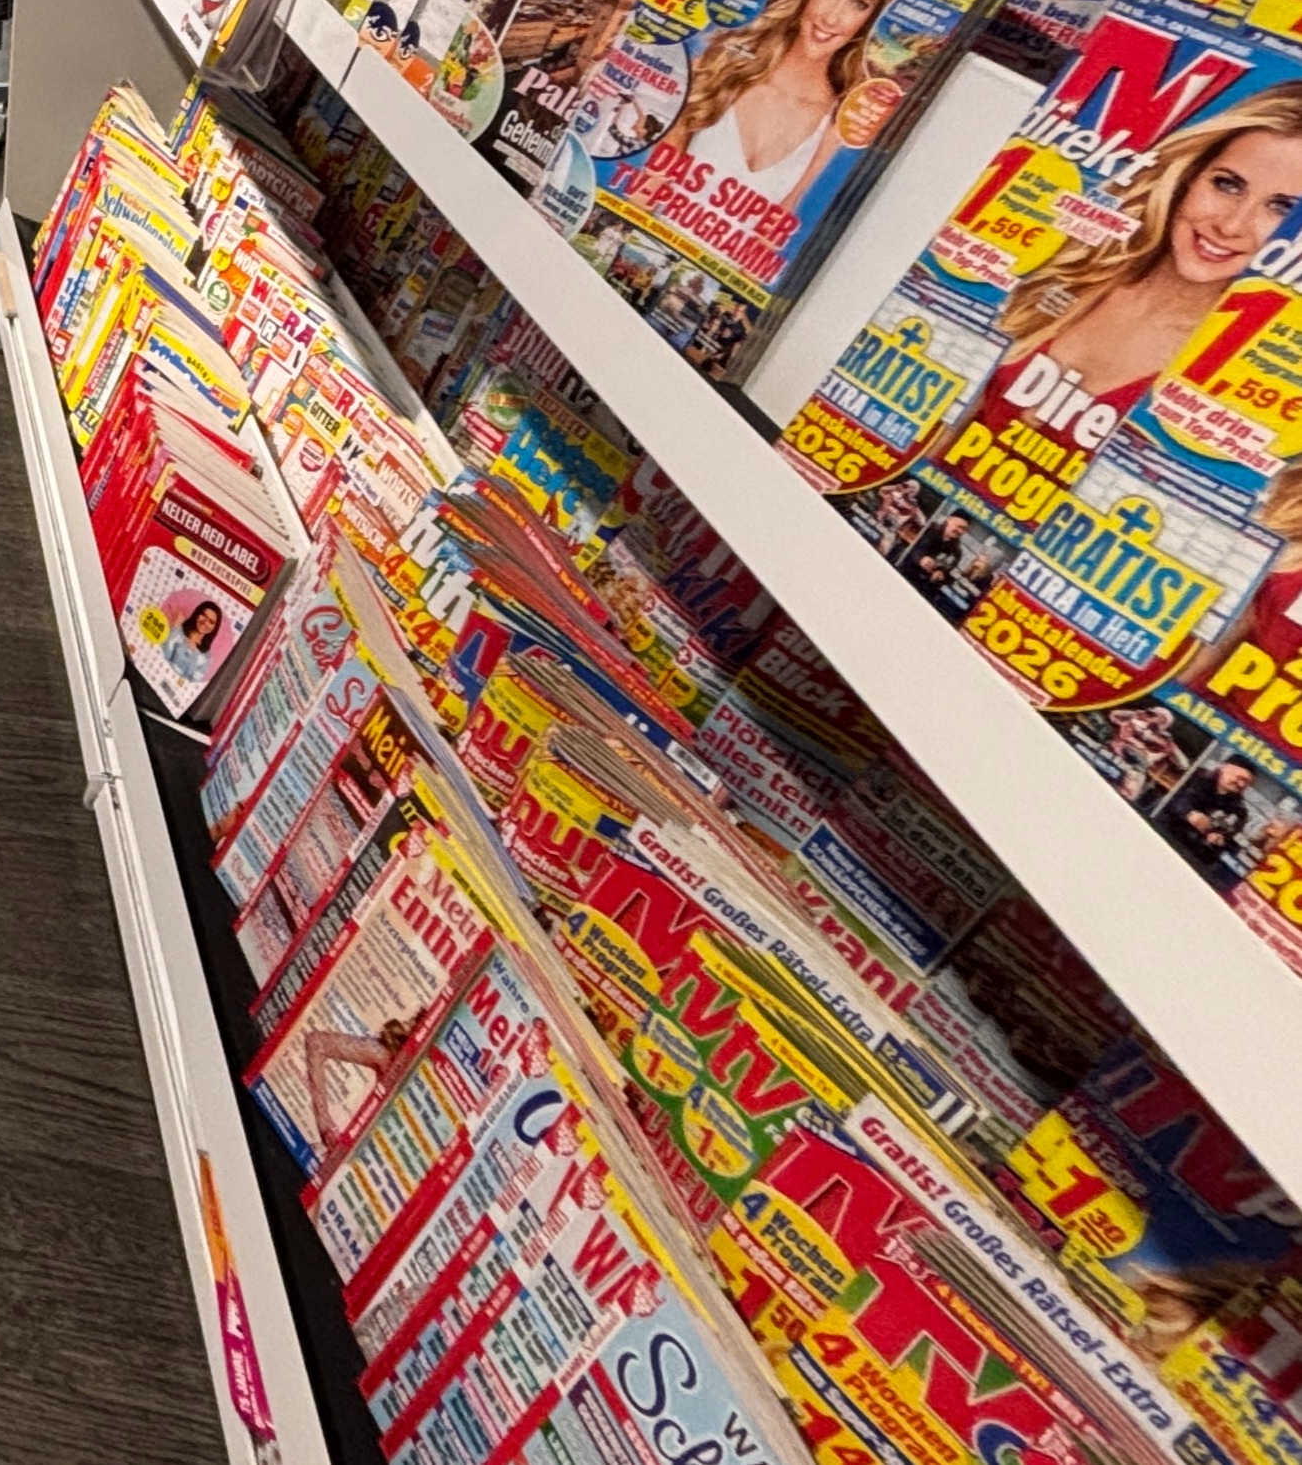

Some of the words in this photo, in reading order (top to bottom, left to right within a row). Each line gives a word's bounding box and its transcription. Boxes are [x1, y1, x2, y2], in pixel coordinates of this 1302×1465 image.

[606, 162, 787, 284] TV-PROGRAMM
[646, 141, 716, 197] DAS
[708, 174, 801, 249] SUPER
[836, 328, 958, 423] GRATIS!
[1151, 399, 1187, 431] zum
[1160, 380, 1204, 416] Mehr
[785, 415, 862, 484] 2026
[916, 462, 958, 499] Alle
[998, 417, 1072, 470] zum
[159, 495, 202, 540] KELTER
[198, 522, 228, 553] RED
[223, 534, 263, 574] LABEL
[1033, 500, 1204, 633] GRATIS!
[1010, 551, 1077, 620] EXTRA
[1099, 615, 1153, 663] Heft
[756, 647, 855, 720] Blick
[965, 604, 1082, 701] 2026
[1166, 685, 1228, 729] Alle
[713, 703, 843, 801] Plötzlich
[589, 921, 648, 980] Wochen
[636, 826, 707, 900] Gratis!
[703, 884, 768, 945] Großes
[765, 938, 877, 1046] Rätsel-Extra
[769, 1207, 847, 1287] Wochen
[858, 1114, 950, 1201] Gratis!
[942, 1198, 1026, 1280] Großes
[1022, 1274, 1175, 1433] Rätsel-Extra
